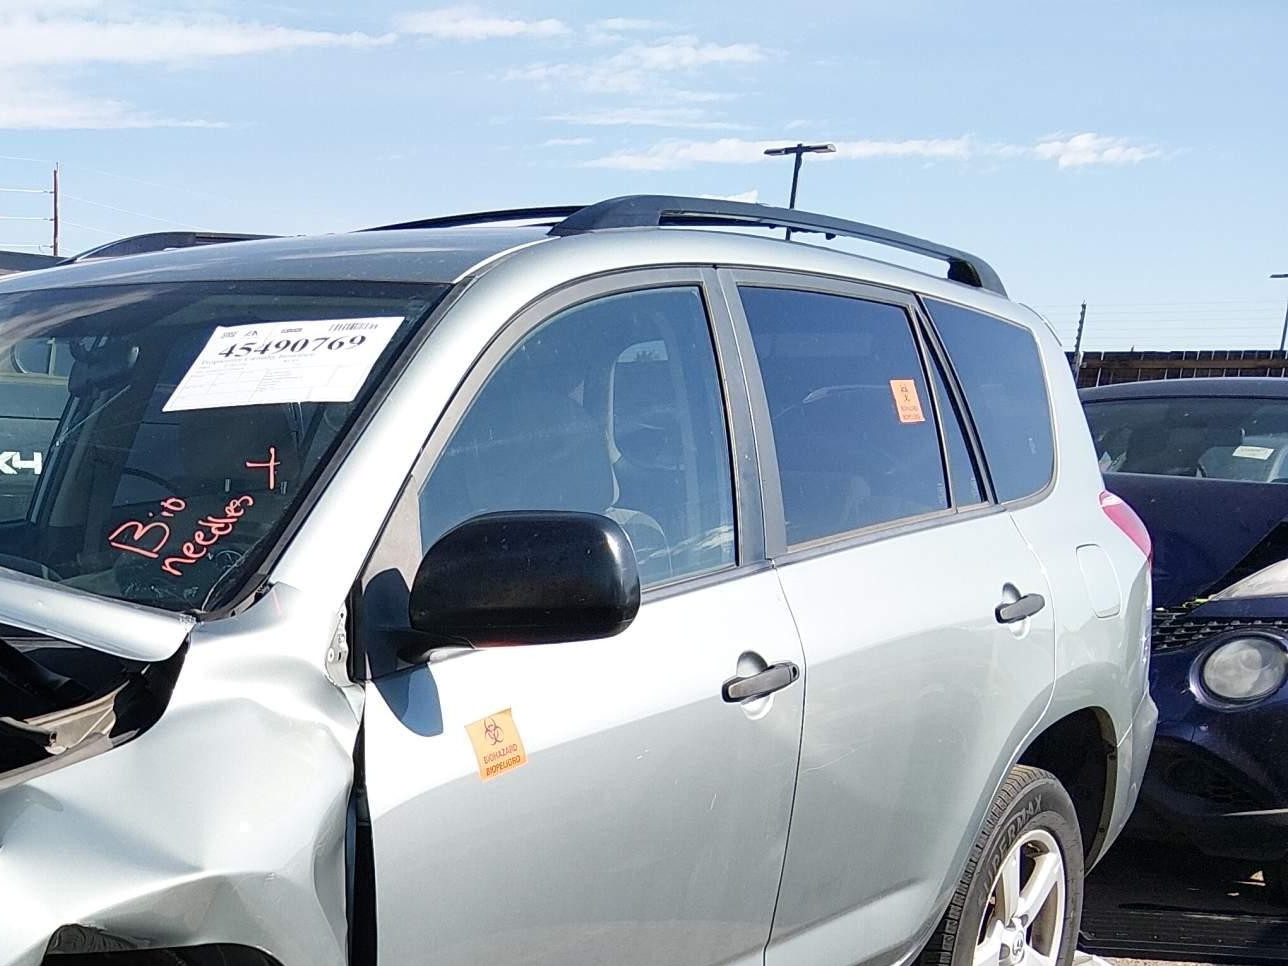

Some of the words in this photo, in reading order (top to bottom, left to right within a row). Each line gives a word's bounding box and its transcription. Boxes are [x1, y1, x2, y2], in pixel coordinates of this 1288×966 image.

[218, 335, 366, 358] 45490769
[108, 497, 186, 559] Bio
[162, 495, 254, 577] needles
